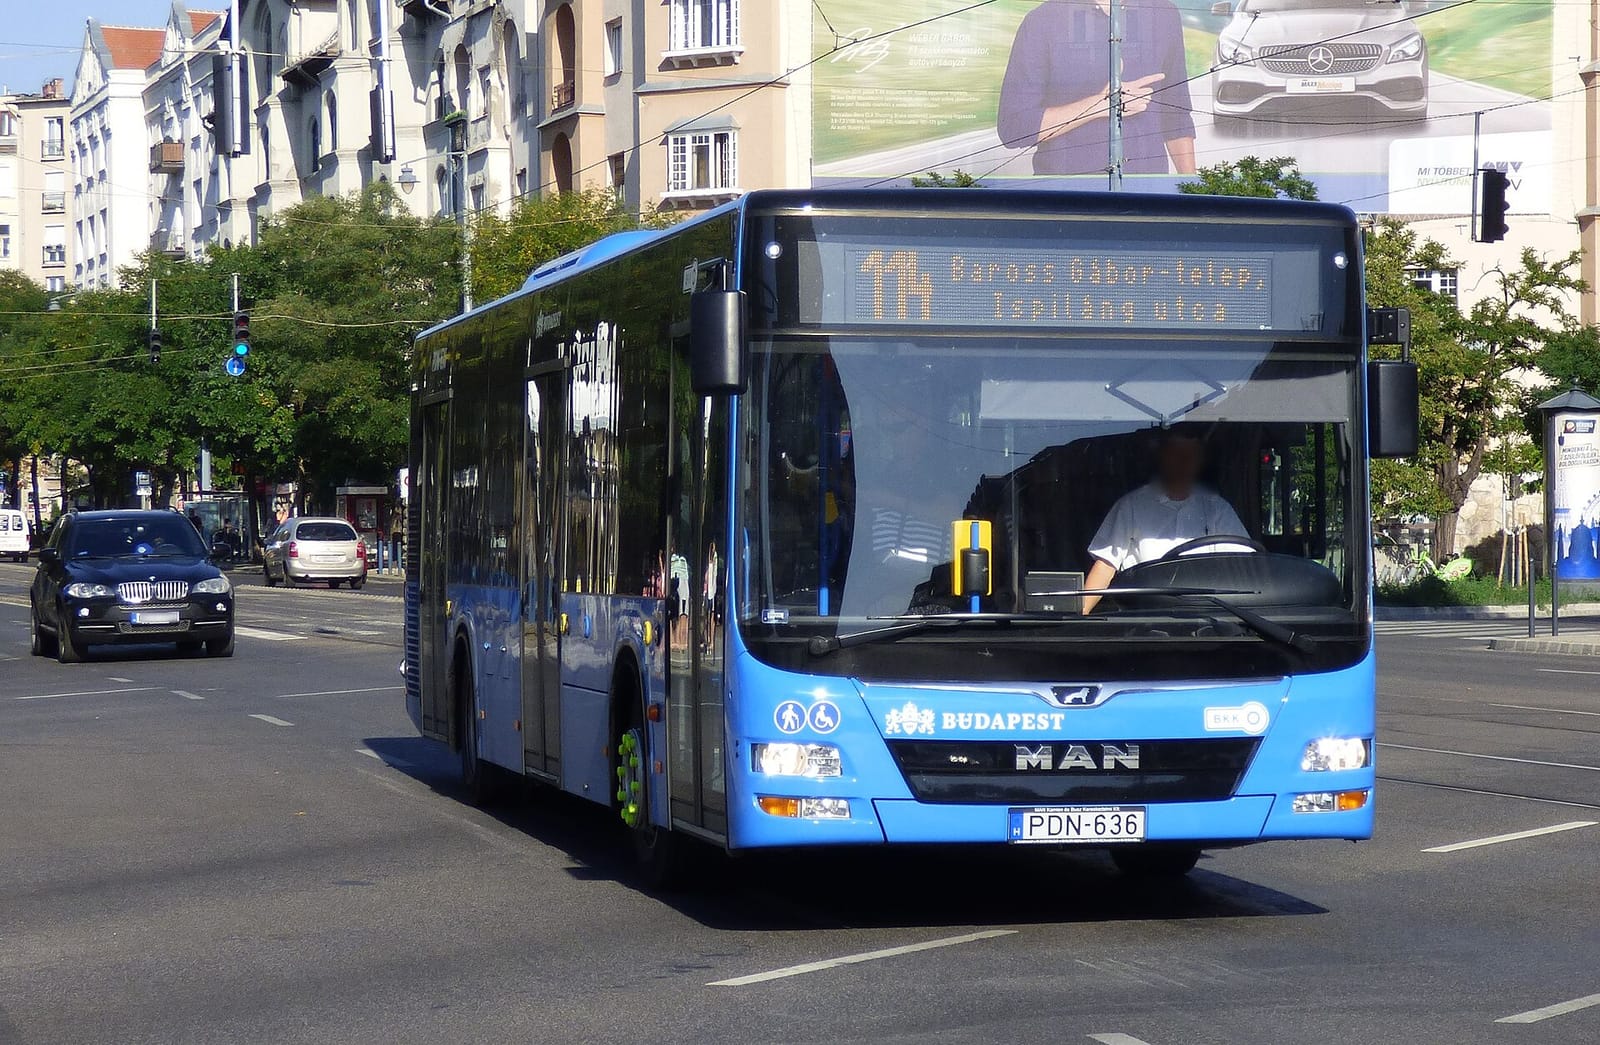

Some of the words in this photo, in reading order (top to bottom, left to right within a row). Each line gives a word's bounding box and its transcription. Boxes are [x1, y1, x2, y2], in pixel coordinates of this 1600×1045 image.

[860, 250, 932, 320] 114
[952, 255, 1055, 283] Baross
[994, 292, 1134, 323] Ispiláng
[1154, 295, 1225, 321] utca
[942, 712, 1065, 731] BUDAPEST
[1213, 714, 1239, 724] BKK
[1014, 743, 1140, 770] MAN
[1029, 814, 1137, 836] PDN-636
